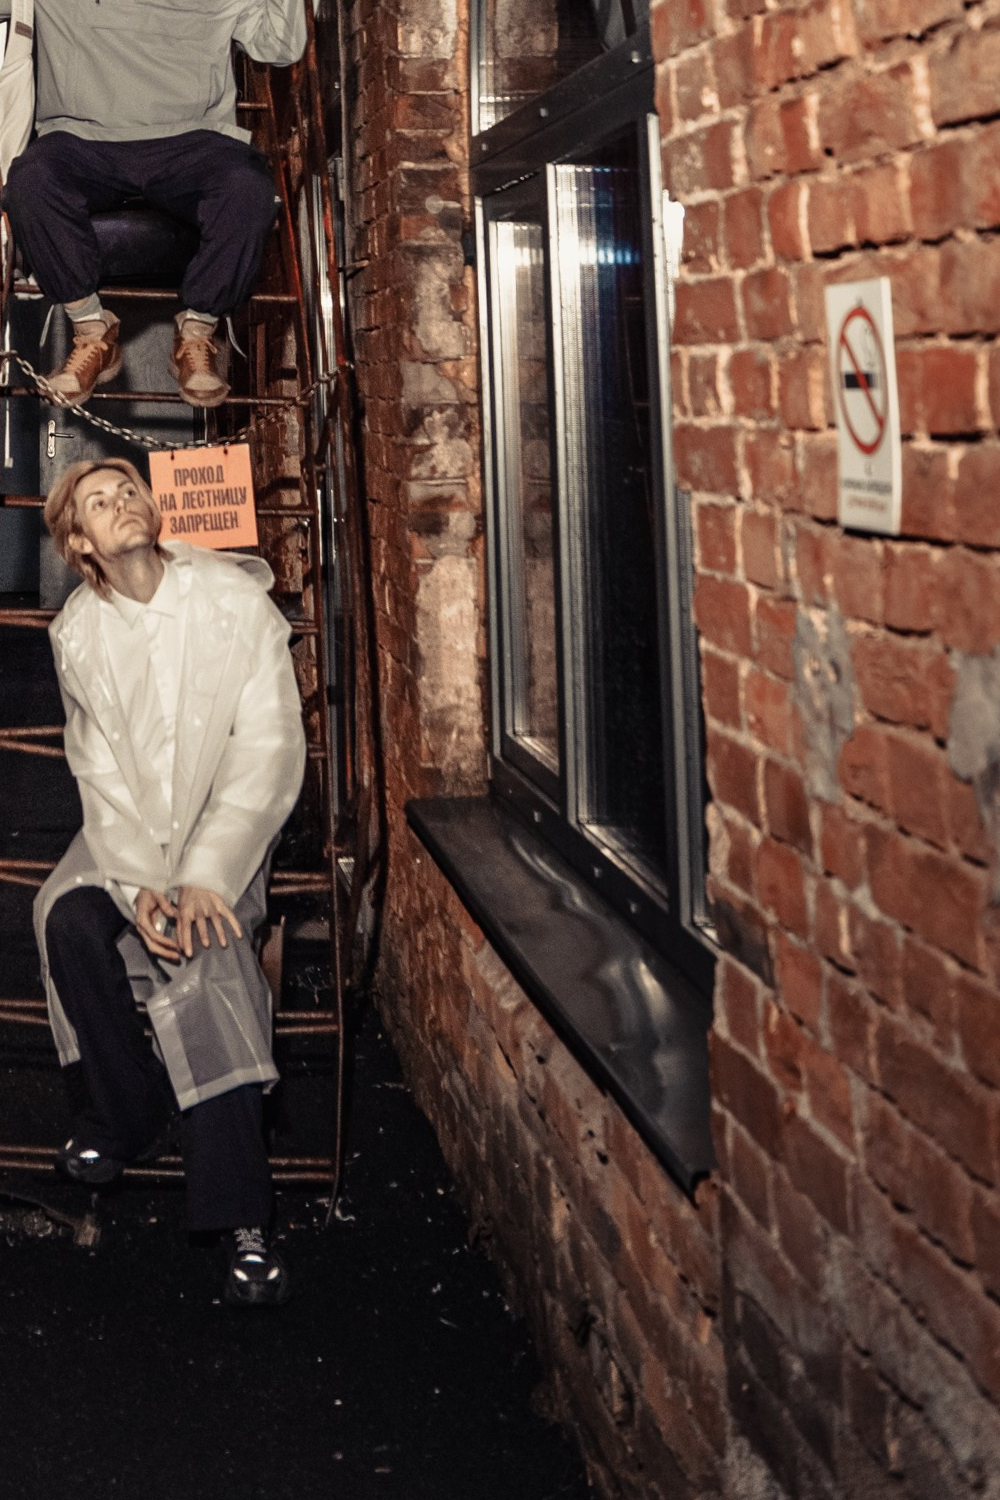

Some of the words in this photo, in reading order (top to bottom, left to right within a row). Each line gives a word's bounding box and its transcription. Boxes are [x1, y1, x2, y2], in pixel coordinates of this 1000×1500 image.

[173, 465, 224, 487] ПРОХОД
[159, 493, 178, 512] НА
[181, 486, 247, 510] ЛЕСТНИЦУ
[169, 511, 239, 534] ЗАПРЕЩЕН
